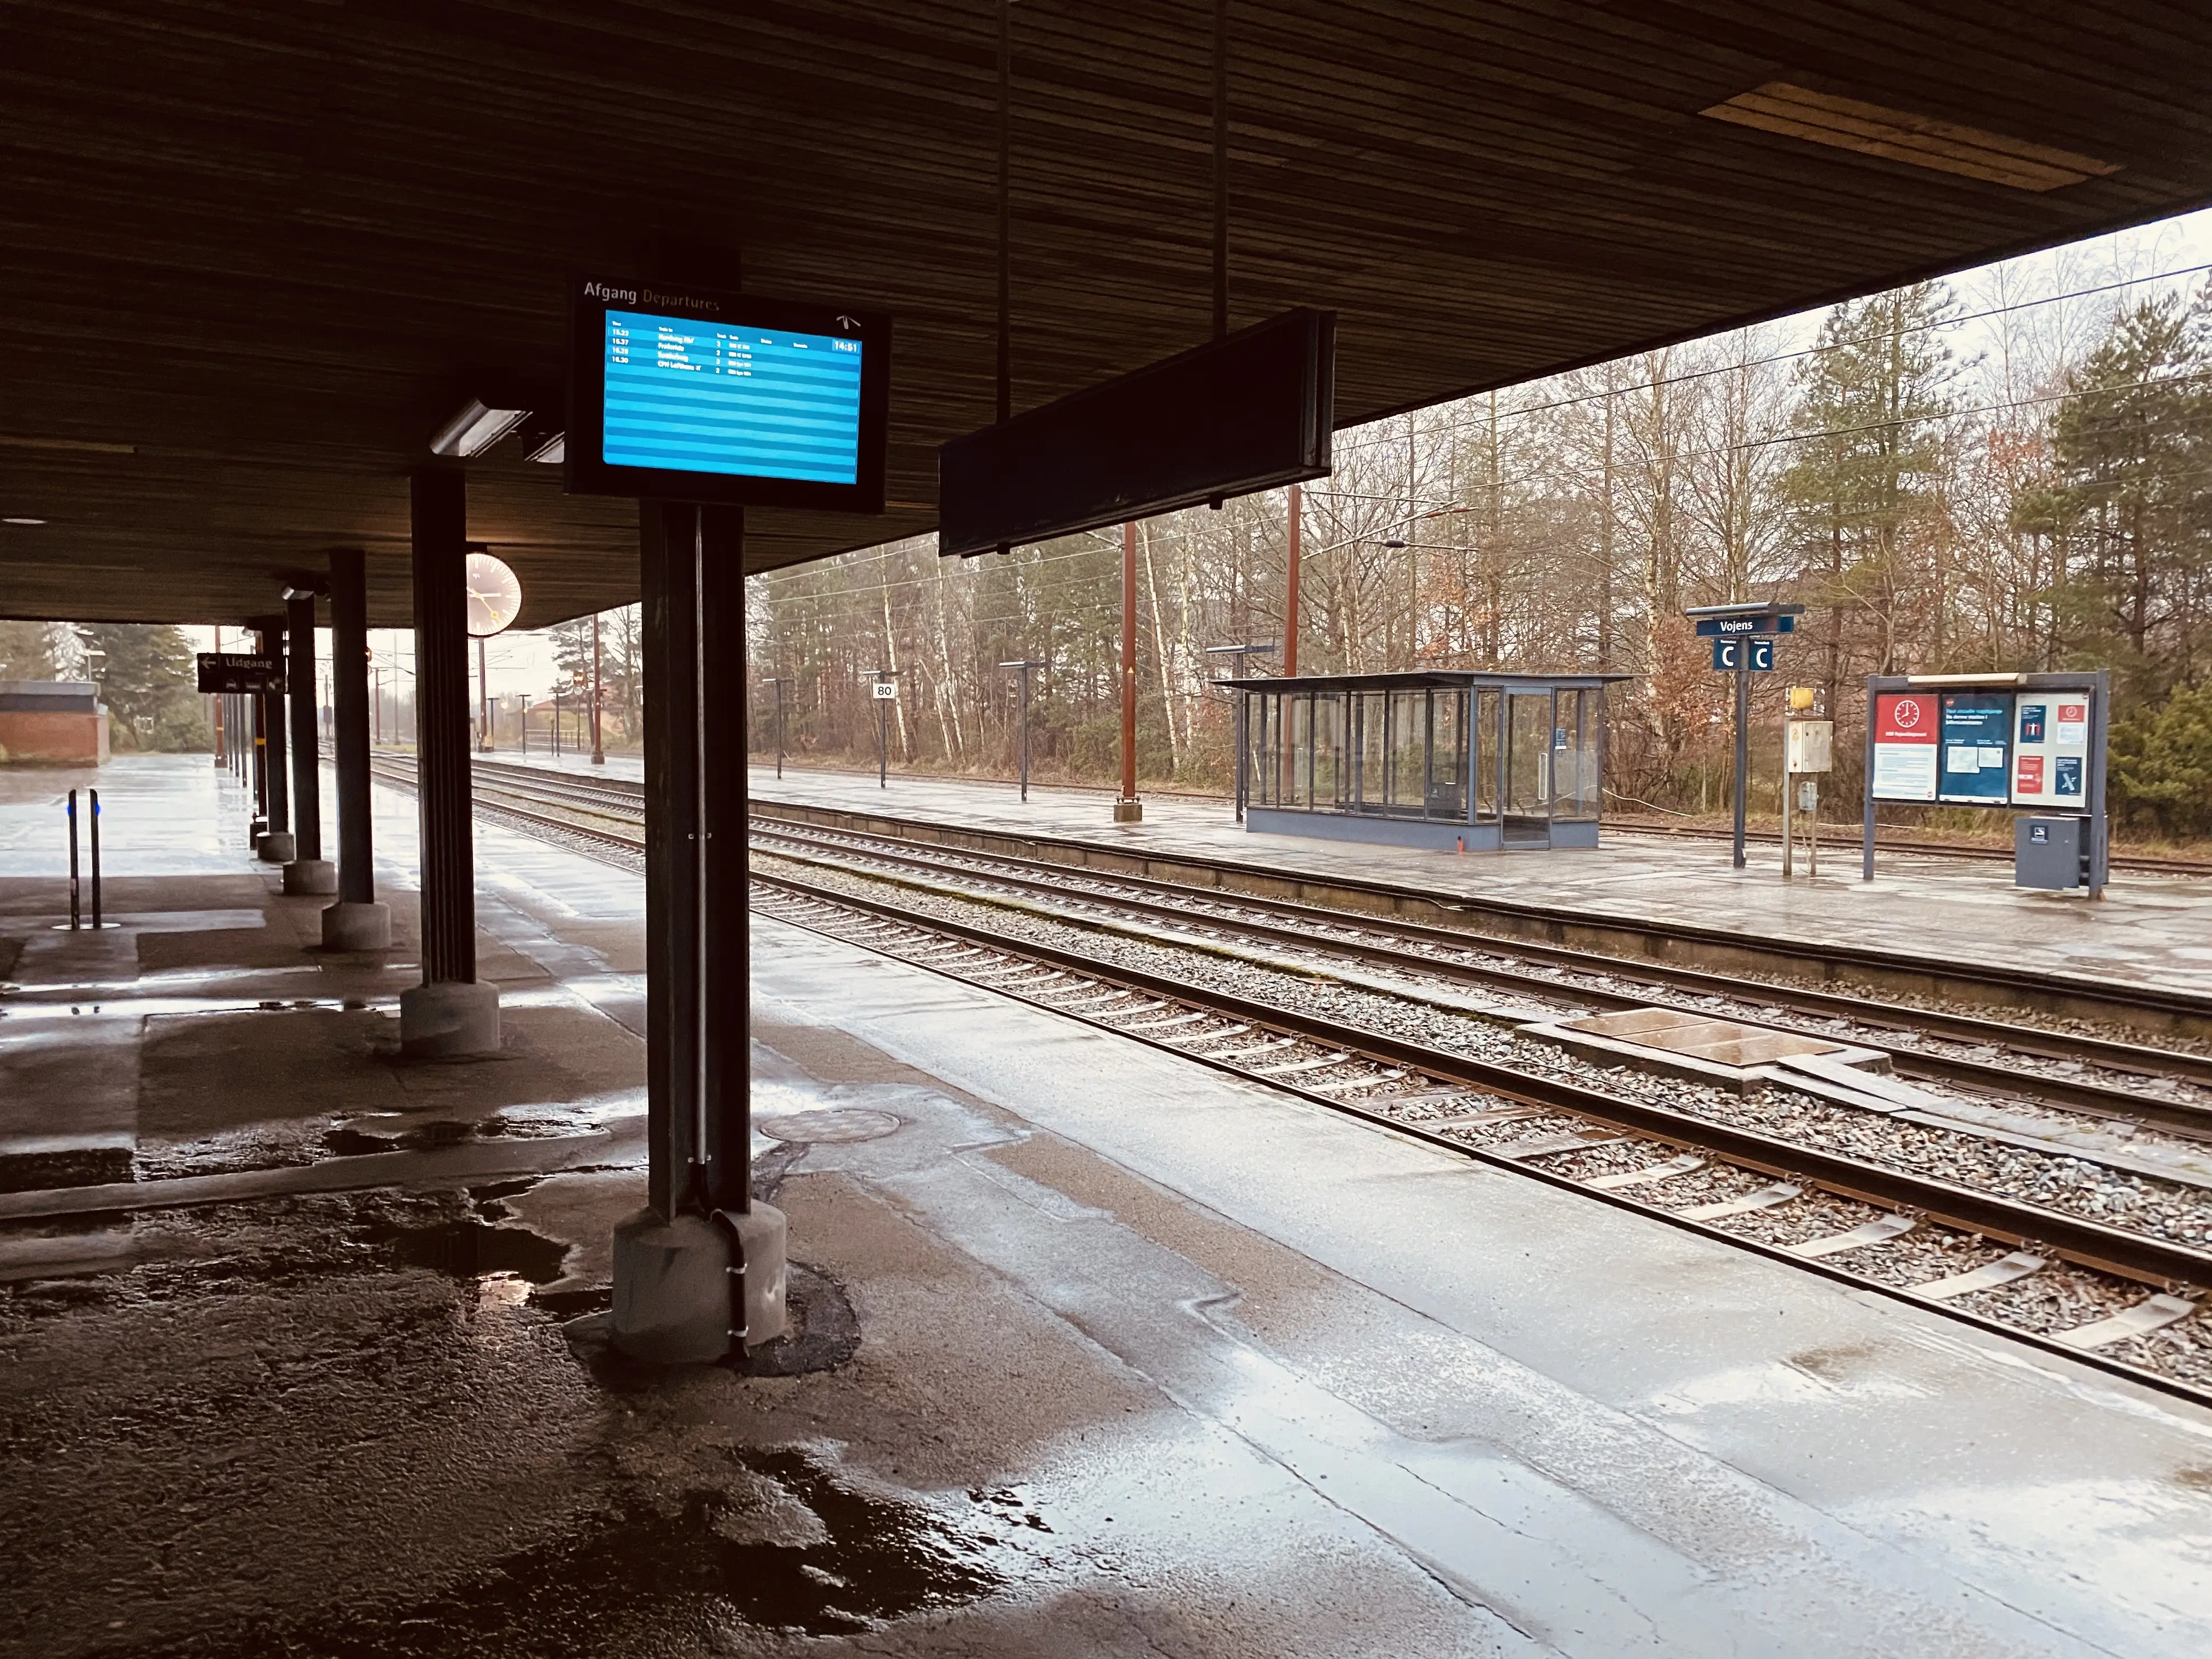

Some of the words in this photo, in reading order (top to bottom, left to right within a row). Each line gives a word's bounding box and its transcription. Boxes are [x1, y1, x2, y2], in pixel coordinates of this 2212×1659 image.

[584, 281, 637, 304] Afgang
[643, 290, 719, 311] Departures
[834, 340, 856, 352] 14:51
[1720, 621, 1753, 633] Vojens
[225, 656, 273, 669] Udgang
[1722, 646, 1734, 666] C
[1756, 648, 1767, 668] C
[878, 686, 891, 695] 80
